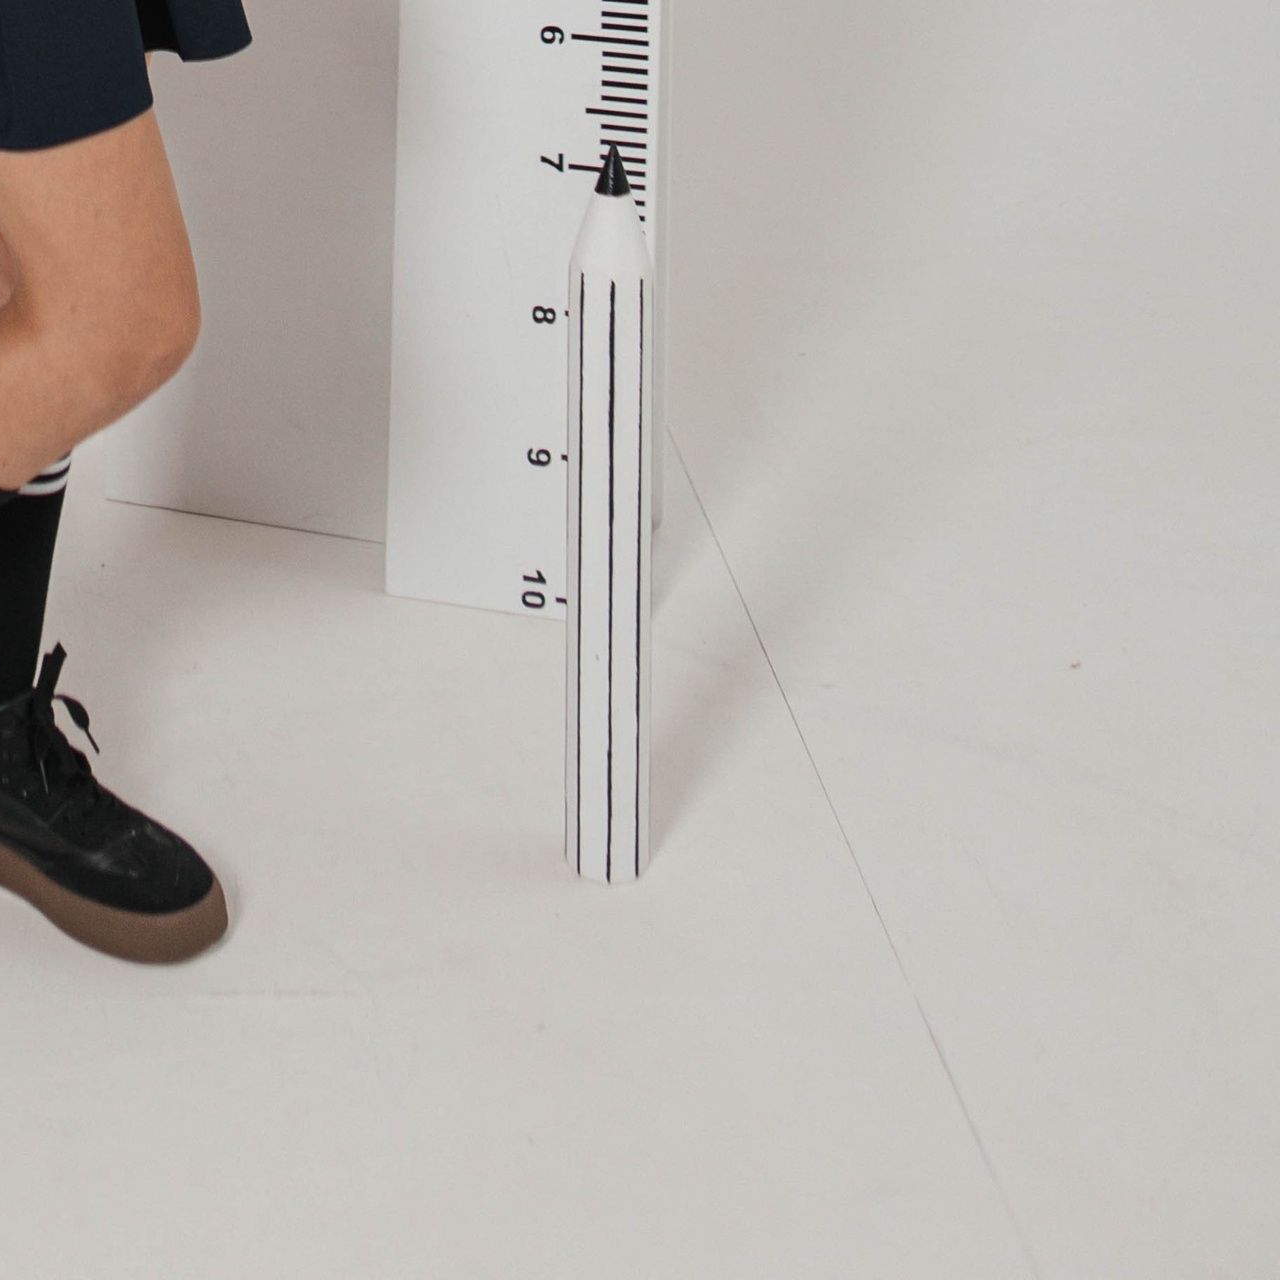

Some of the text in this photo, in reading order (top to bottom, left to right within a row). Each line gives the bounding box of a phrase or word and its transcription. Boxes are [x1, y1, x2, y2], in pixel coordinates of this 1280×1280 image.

[540, 25, 565, 45] 6
[539, 152, 564, 173] 7
[532, 305, 557, 325] 8
[527, 448, 552, 467] 9
[521, 569, 547, 609] 10
